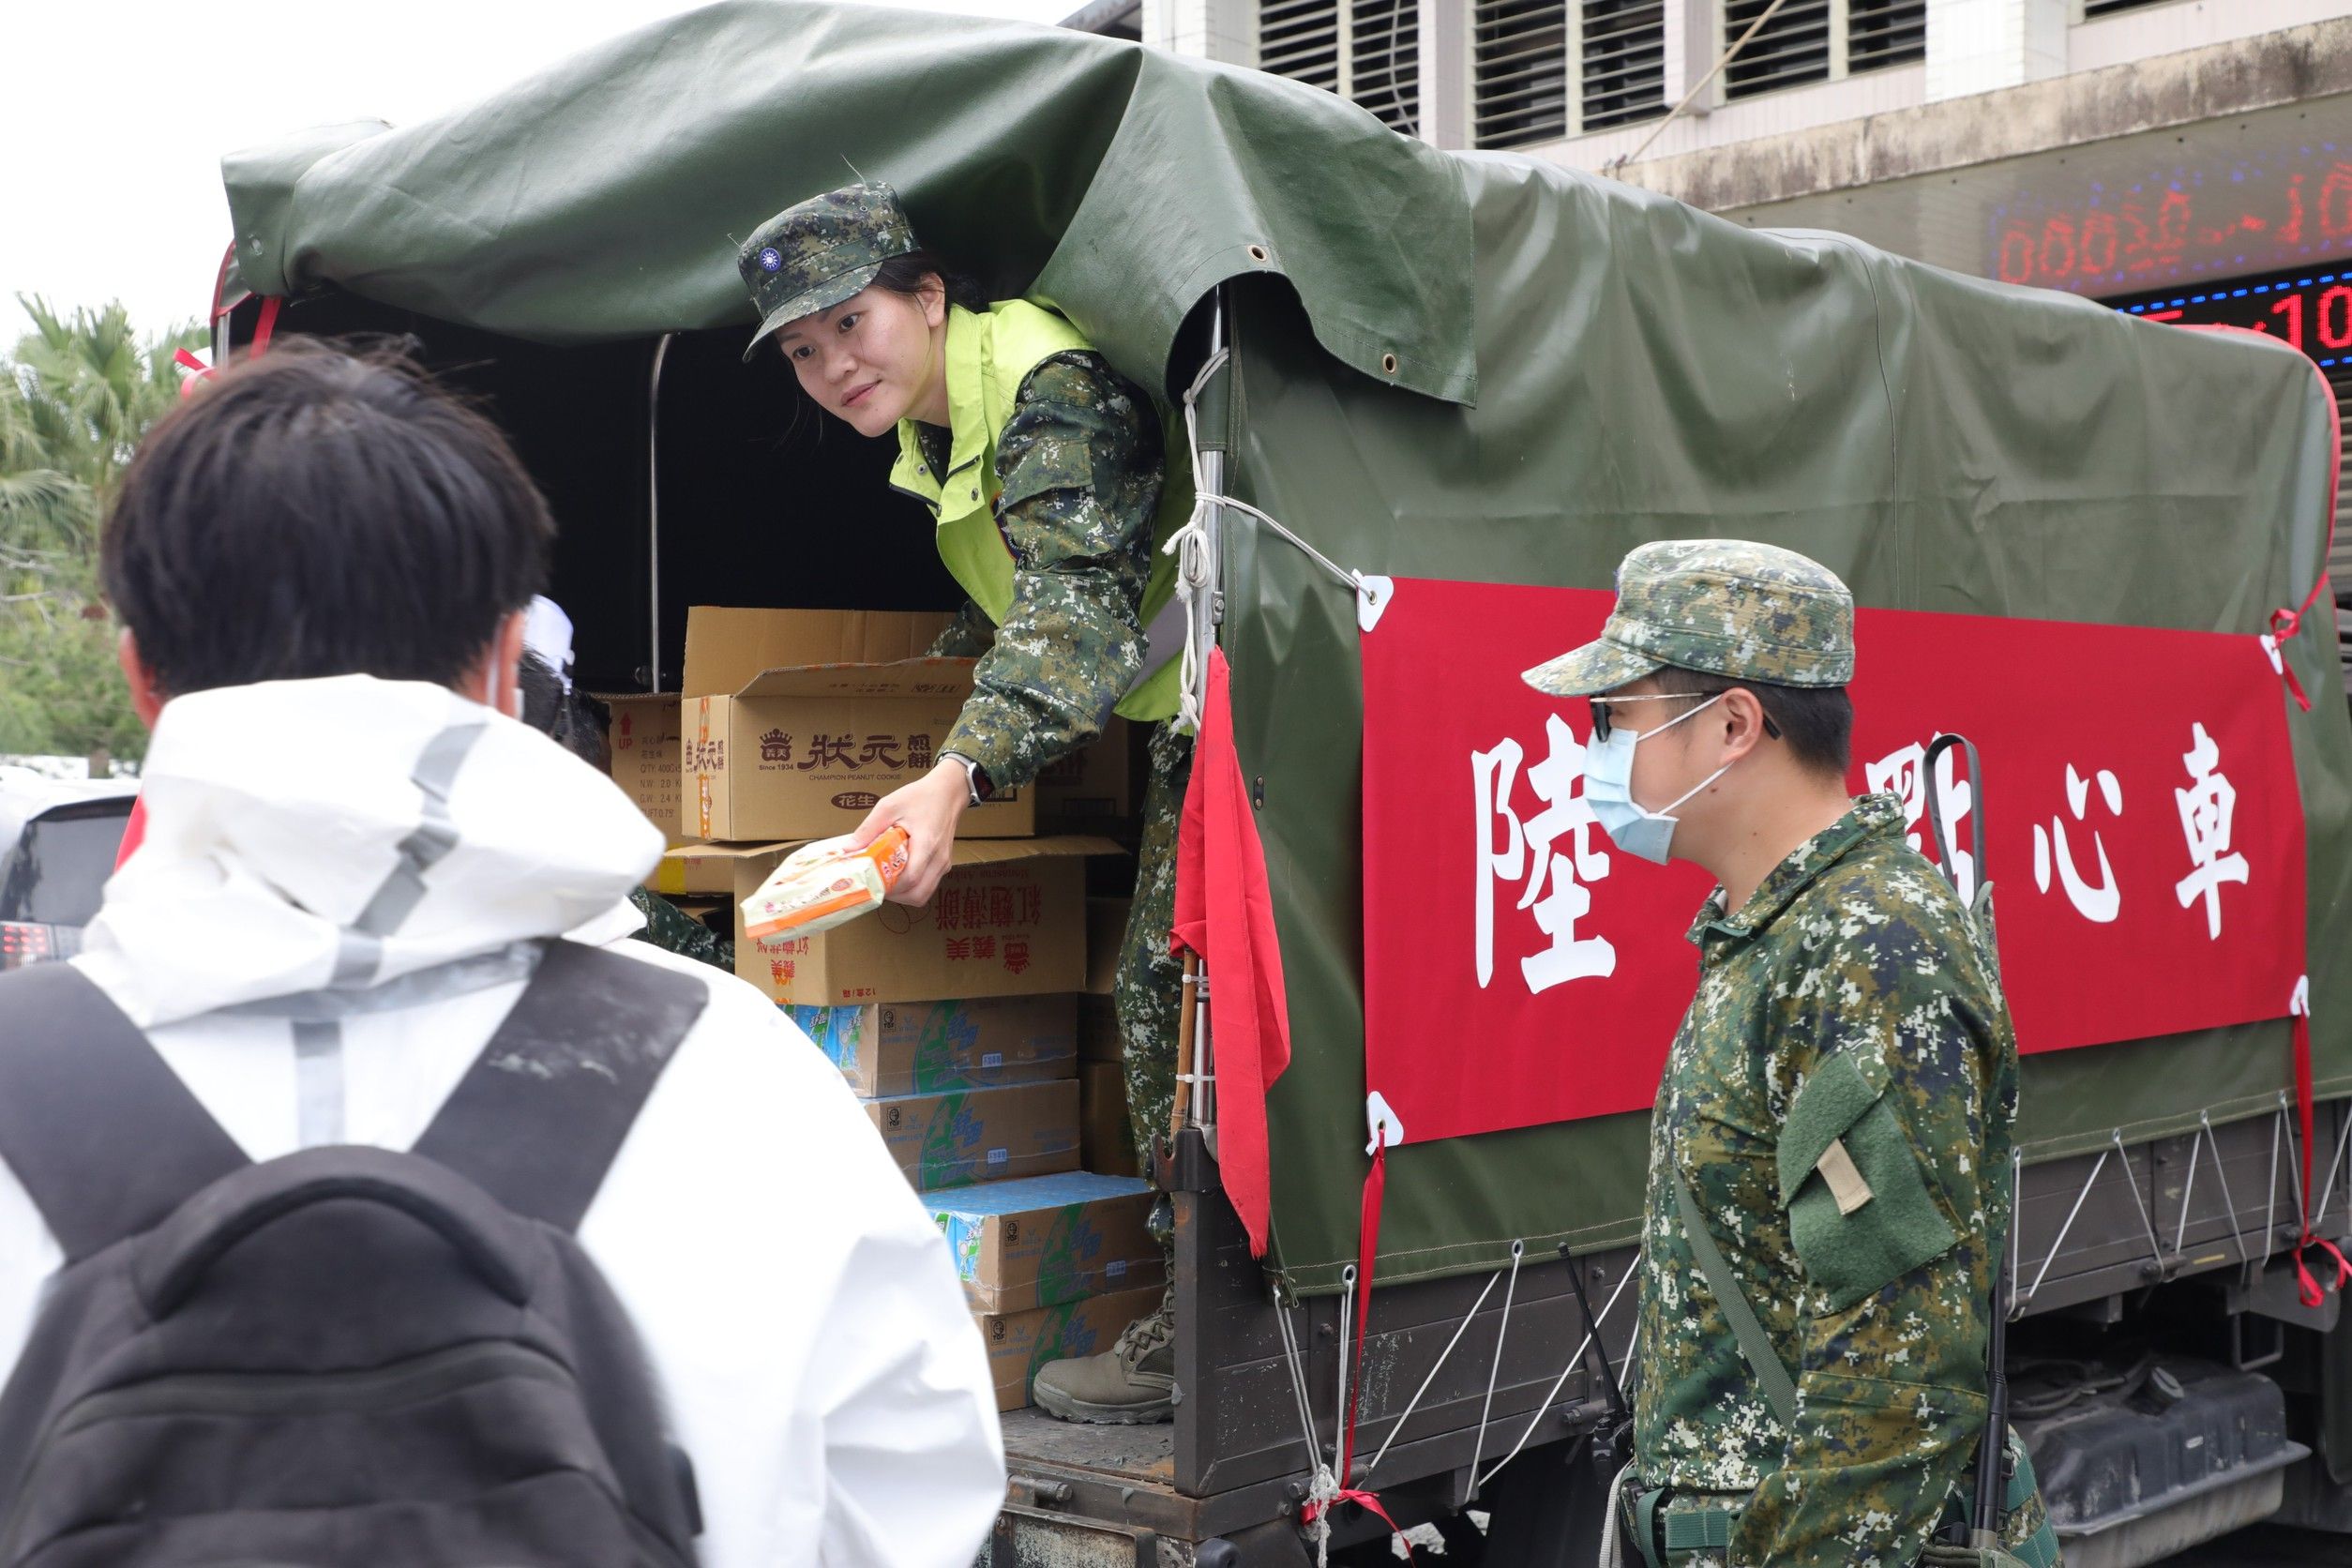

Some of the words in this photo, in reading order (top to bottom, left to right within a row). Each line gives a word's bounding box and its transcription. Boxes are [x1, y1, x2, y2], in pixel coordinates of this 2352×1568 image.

[619, 737, 633, 750] UP
[797, 734, 907, 771] 狀元
[839, 794, 874, 807] 花生
[1472, 710, 2250, 996] 陸點心車
[945, 935, 995, 960] 義美
